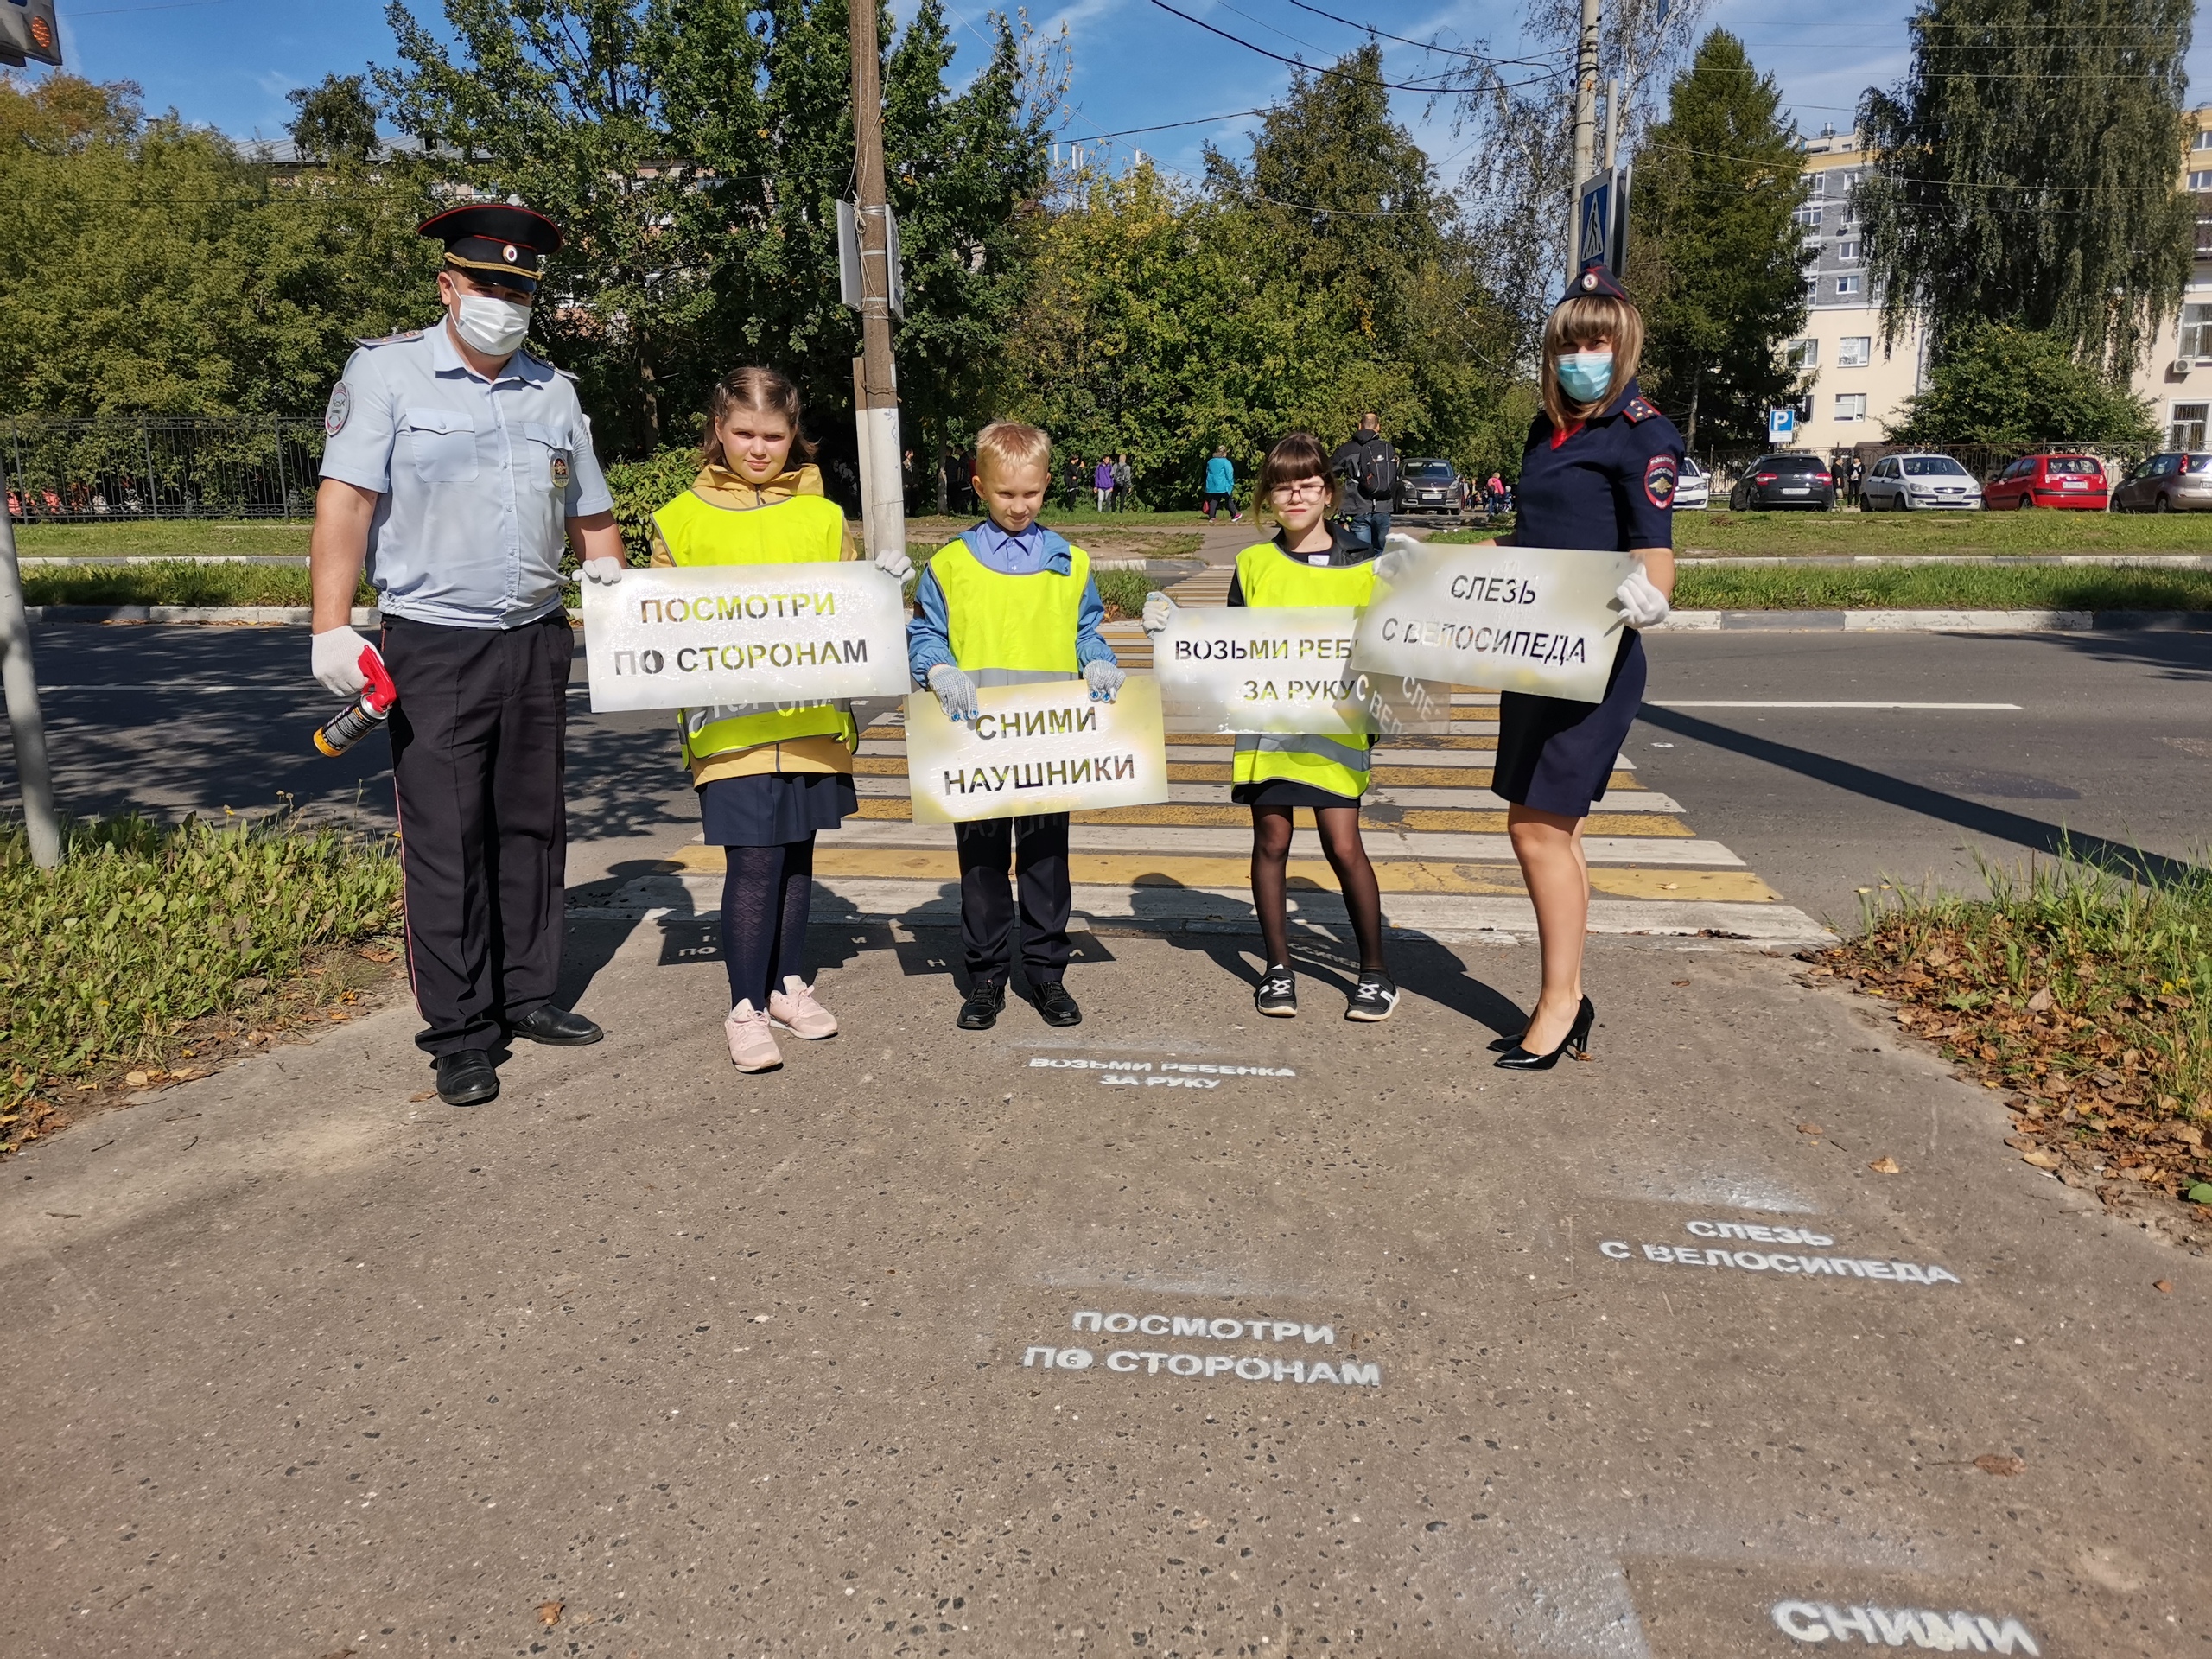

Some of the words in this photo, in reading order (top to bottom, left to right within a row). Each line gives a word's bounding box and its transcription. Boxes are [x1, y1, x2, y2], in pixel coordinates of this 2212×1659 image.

[1451, 575, 1536, 604] СЛЕЗЬ
[640, 591, 835, 623] ПОСМОТРИ
[614, 649, 664, 675] ПО
[677, 639, 868, 672] СТОРОНАМ
[1175, 639, 1288, 660] ВОЗЬМИ
[1299, 639, 1357, 659] РЕБ
[1382, 618, 1400, 641] С
[1402, 622, 1586, 664] ВЕЛОСИПЕДА
[1243, 681, 1279, 701] ЗА
[1288, 680, 1356, 701] РУКУ
[975, 706, 1097, 741] СНИМИ
[944, 754, 1135, 796] НАУШНИКИ
[1029, 1058, 1152, 1071] ВОЗЬМИ
[1161, 1061, 1296, 1077] РЕБЕНКА
[1100, 1074, 1139, 1086] ЗА
[1145, 1077, 1222, 1089] РУКУ
[1686, 1221, 1834, 1246] СЛЕЗЬ
[1599, 1242, 1631, 1259] С
[1643, 1244, 1962, 1285] ВЕЛОСИПЕДА
[1071, 1311, 1335, 1344] ПОСМОТРИ
[1023, 1346, 1094, 1370] ПО
[1106, 1351, 1380, 1386] СТОРОНАМ
[1772, 1599, 2040, 1656] СНИМИ
